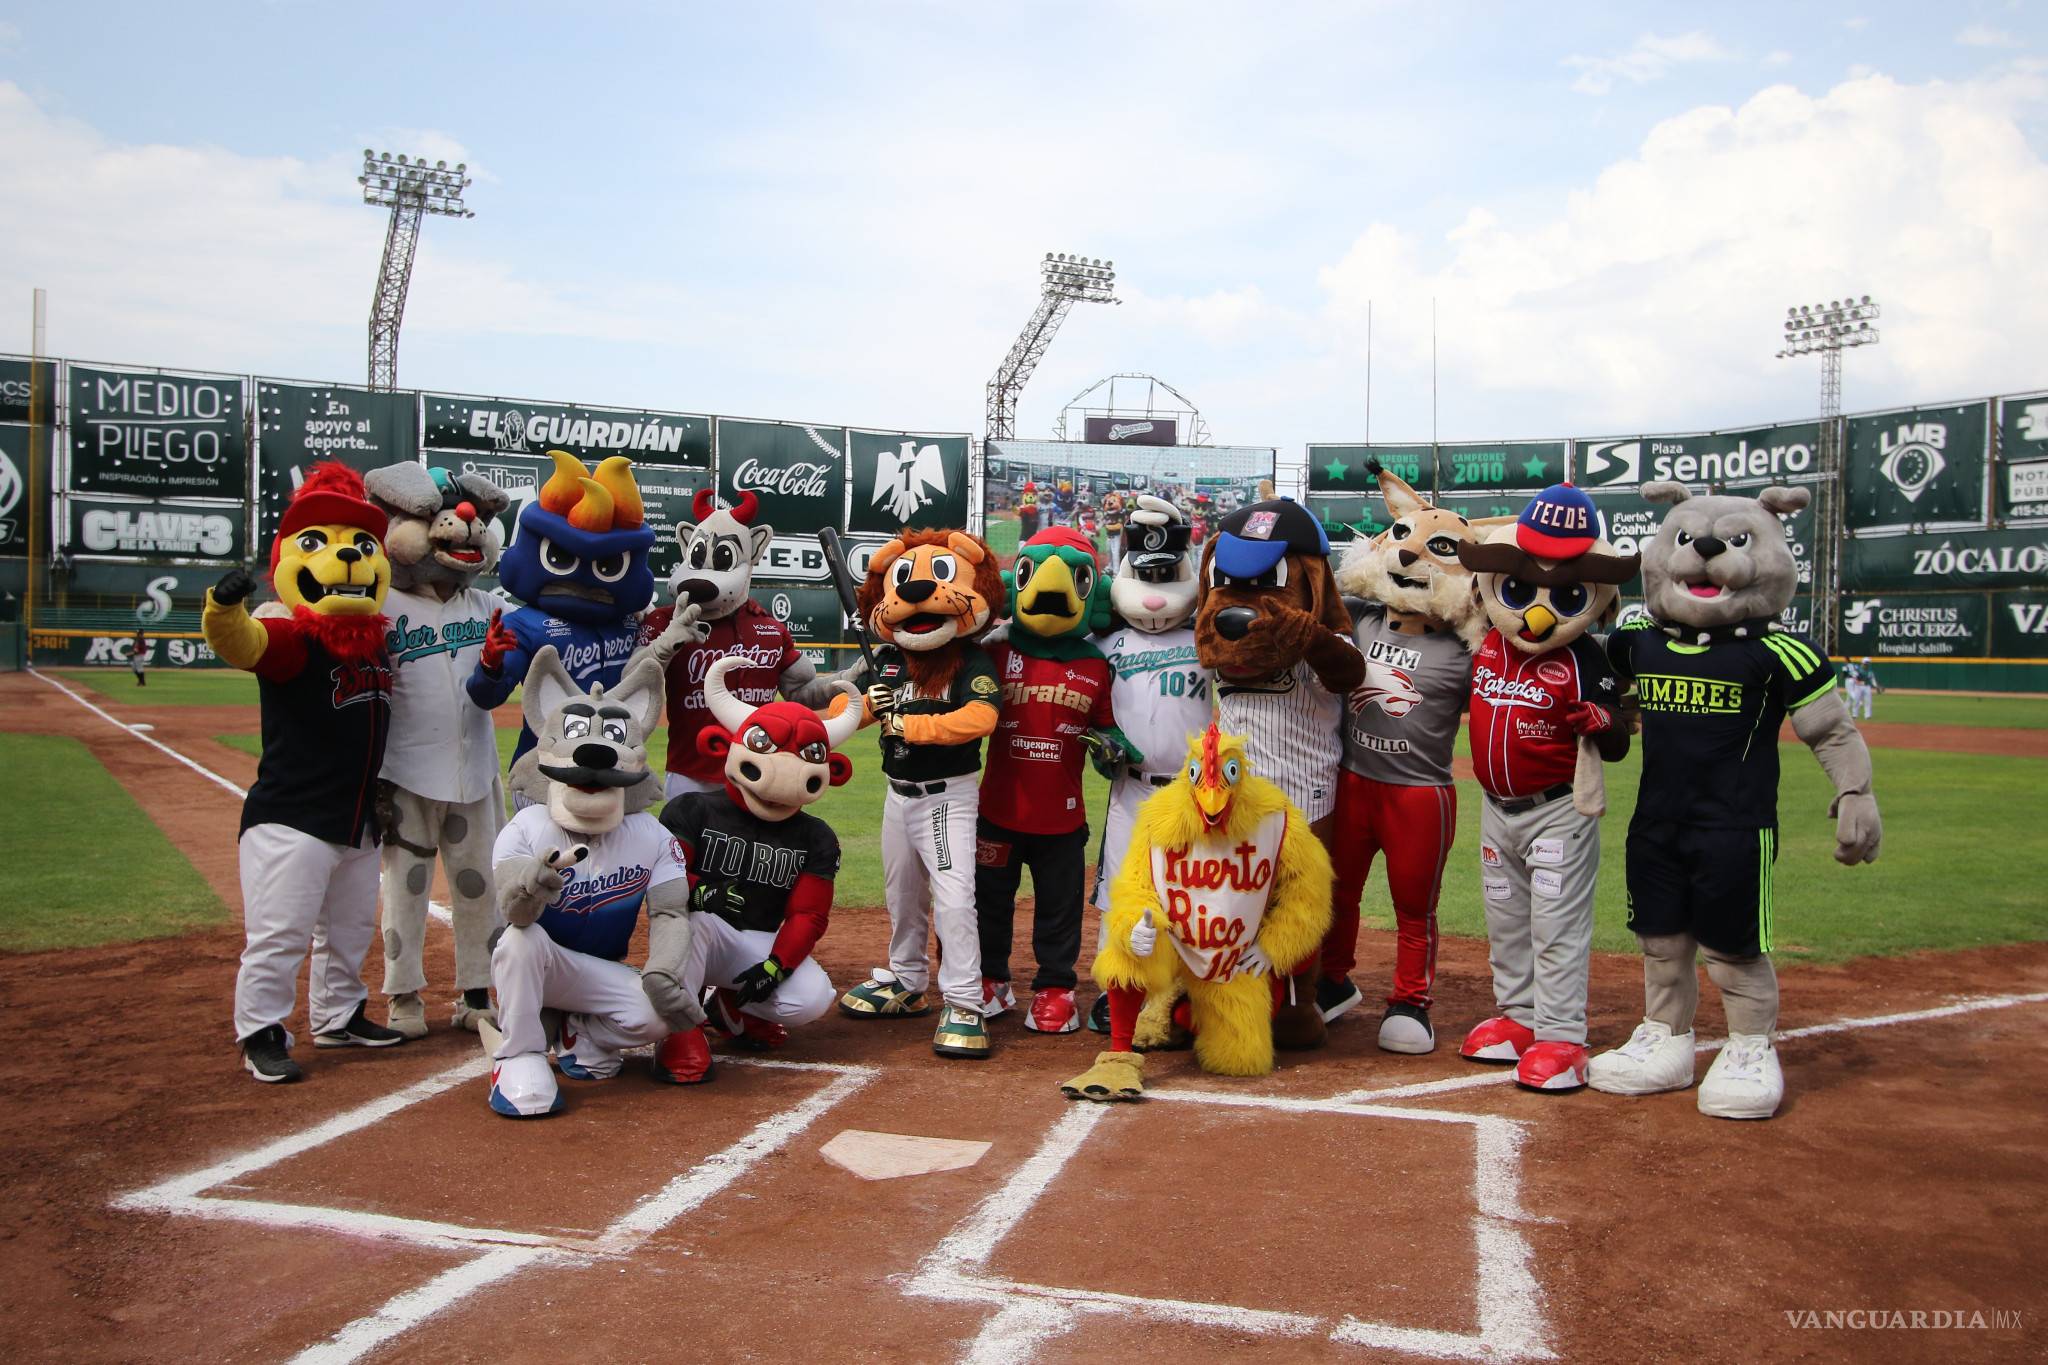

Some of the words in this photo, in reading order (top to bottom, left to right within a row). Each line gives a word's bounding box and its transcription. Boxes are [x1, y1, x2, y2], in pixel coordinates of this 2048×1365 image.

[98, 378, 220, 418] MEDIO
[329, 401, 349, 415] En
[305, 420, 352, 434] apoyo
[357, 419, 371, 432] al
[469, 410, 505, 437] EL
[526, 419, 682, 452] GUARDIÁN
[1652, 443, 1683, 455] Plaza
[1880, 423, 1947, 456] LMB
[1452, 453, 1506, 463] CAMPEONES
[1654, 440, 1810, 482] sendero
[99, 472, 159, 484] INSPIRACIÓN
[168, 476, 219, 486] IMPRESIÓN
[733, 458, 831, 497] Coca-Cola
[1454, 462, 1503, 484] 2010
[641, 485, 673, 495] NUESTRAS
[673, 488, 693, 497] REDES
[1531, 500, 1587, 529] TECOS
[1913, 541, 2041, 575] ZÓCALO
[1879, 607, 1957, 623] CHRISTUS
[1879, 623, 1968, 637] MUGUERZA
[1879, 642, 1916, 655] Hospital
[1918, 642, 1952, 653] Saltillo
[1473, 665, 1546, 703] Laredos
[1637, 678, 1742, 708] UMBRES
[1646, 702, 1709, 714] SALTILLO
[1166, 841, 1271, 891] Puerto
[1167, 888, 1246, 950] Rico
